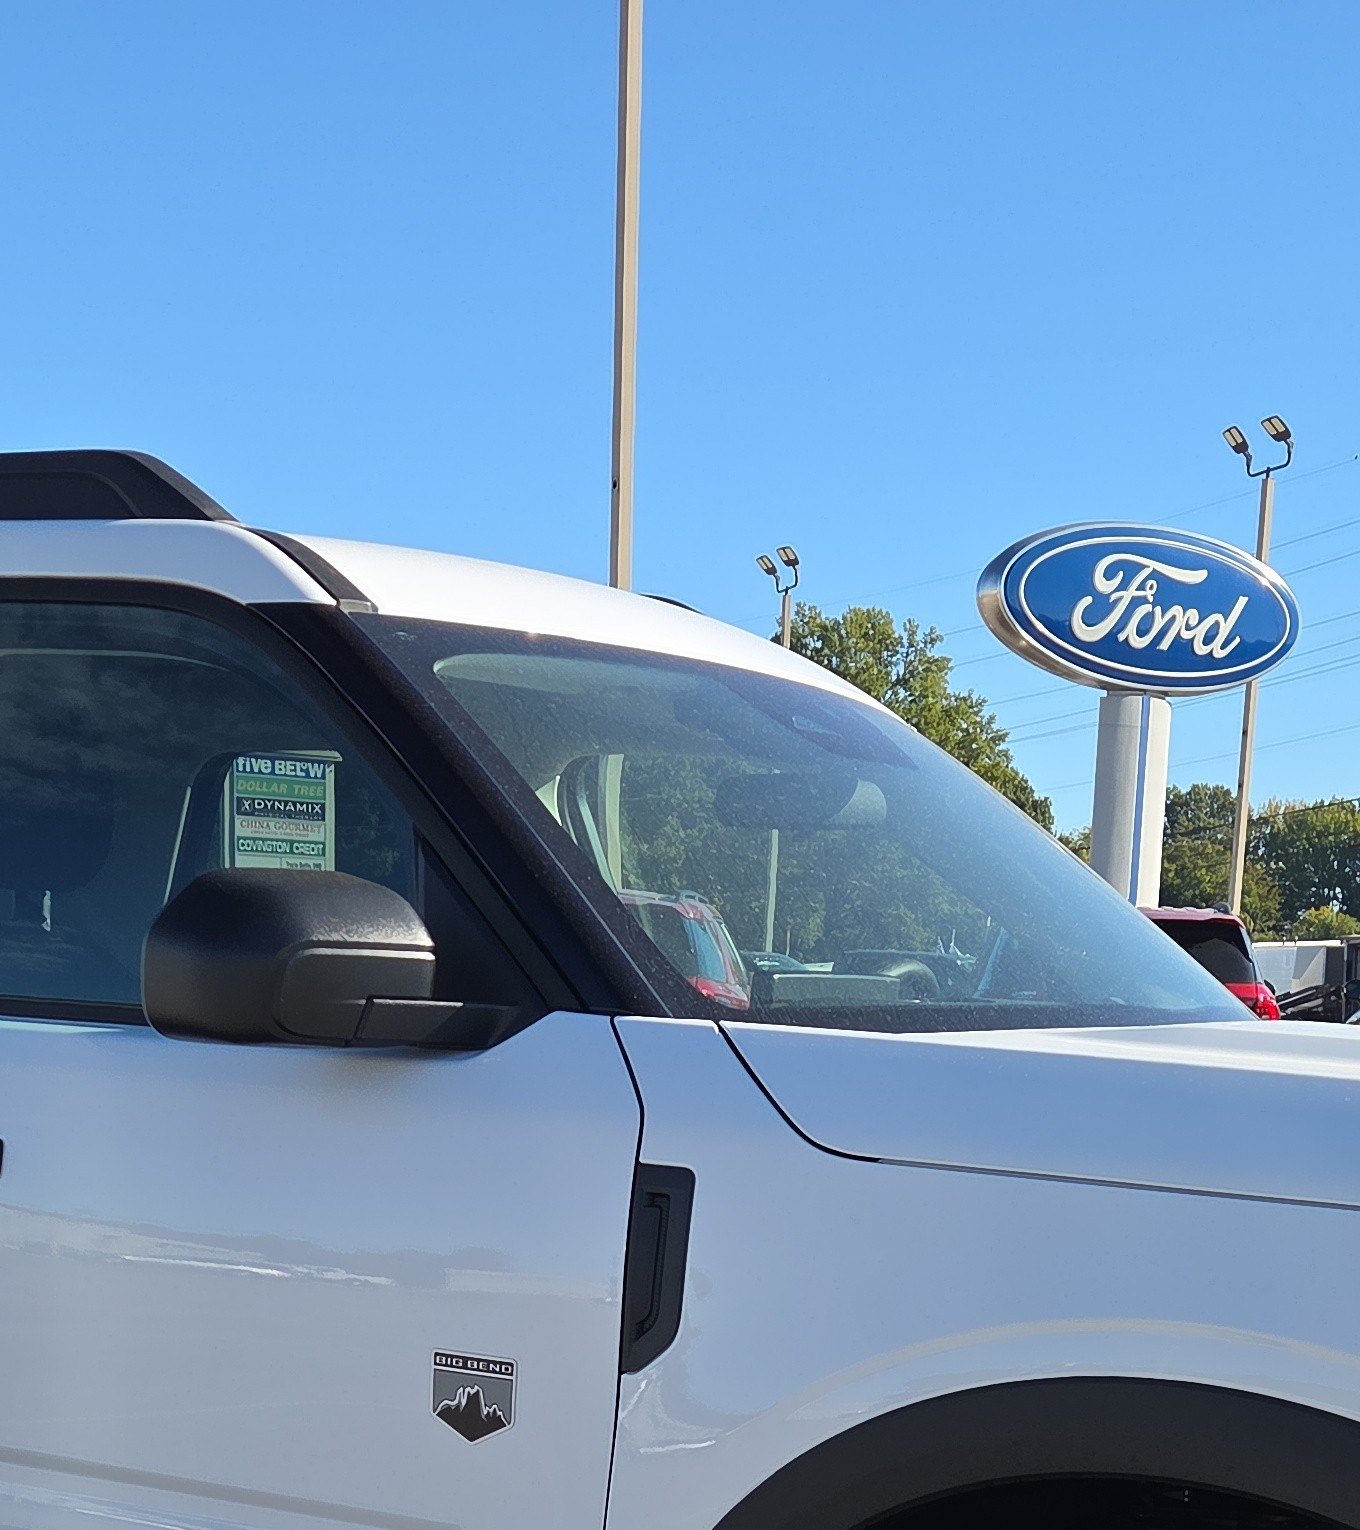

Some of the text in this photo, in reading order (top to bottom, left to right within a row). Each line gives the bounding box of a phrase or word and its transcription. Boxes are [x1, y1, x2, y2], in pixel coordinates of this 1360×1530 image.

[1070, 553, 1249, 659] Ford
[237, 757, 272, 774] five
[237, 780, 324, 797] DOLLAR TREE
[254, 799, 322, 814] DYNAMIX
[240, 820, 271, 830] CHINA
[238, 839, 324, 856] COVINGTON CREDIT
[436, 1355, 512, 1374] BIG BEND
